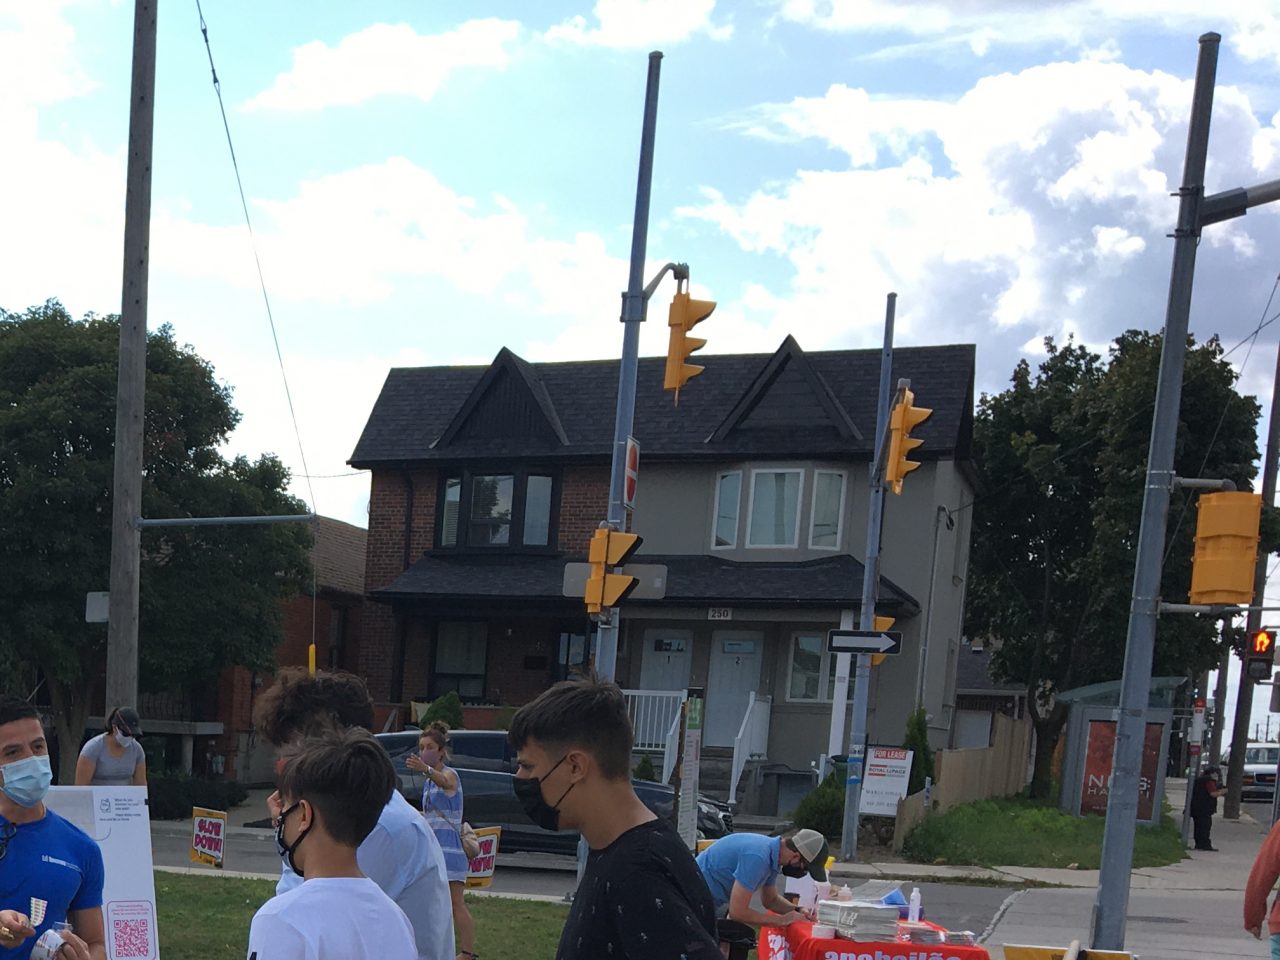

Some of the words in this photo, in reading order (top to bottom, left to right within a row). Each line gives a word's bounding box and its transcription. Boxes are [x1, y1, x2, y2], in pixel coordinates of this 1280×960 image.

[712, 609, 728, 618] 250
[876, 750, 886, 758] FOR
[888, 751, 906, 759] LEASE
[198, 819, 221, 836] SLOW
